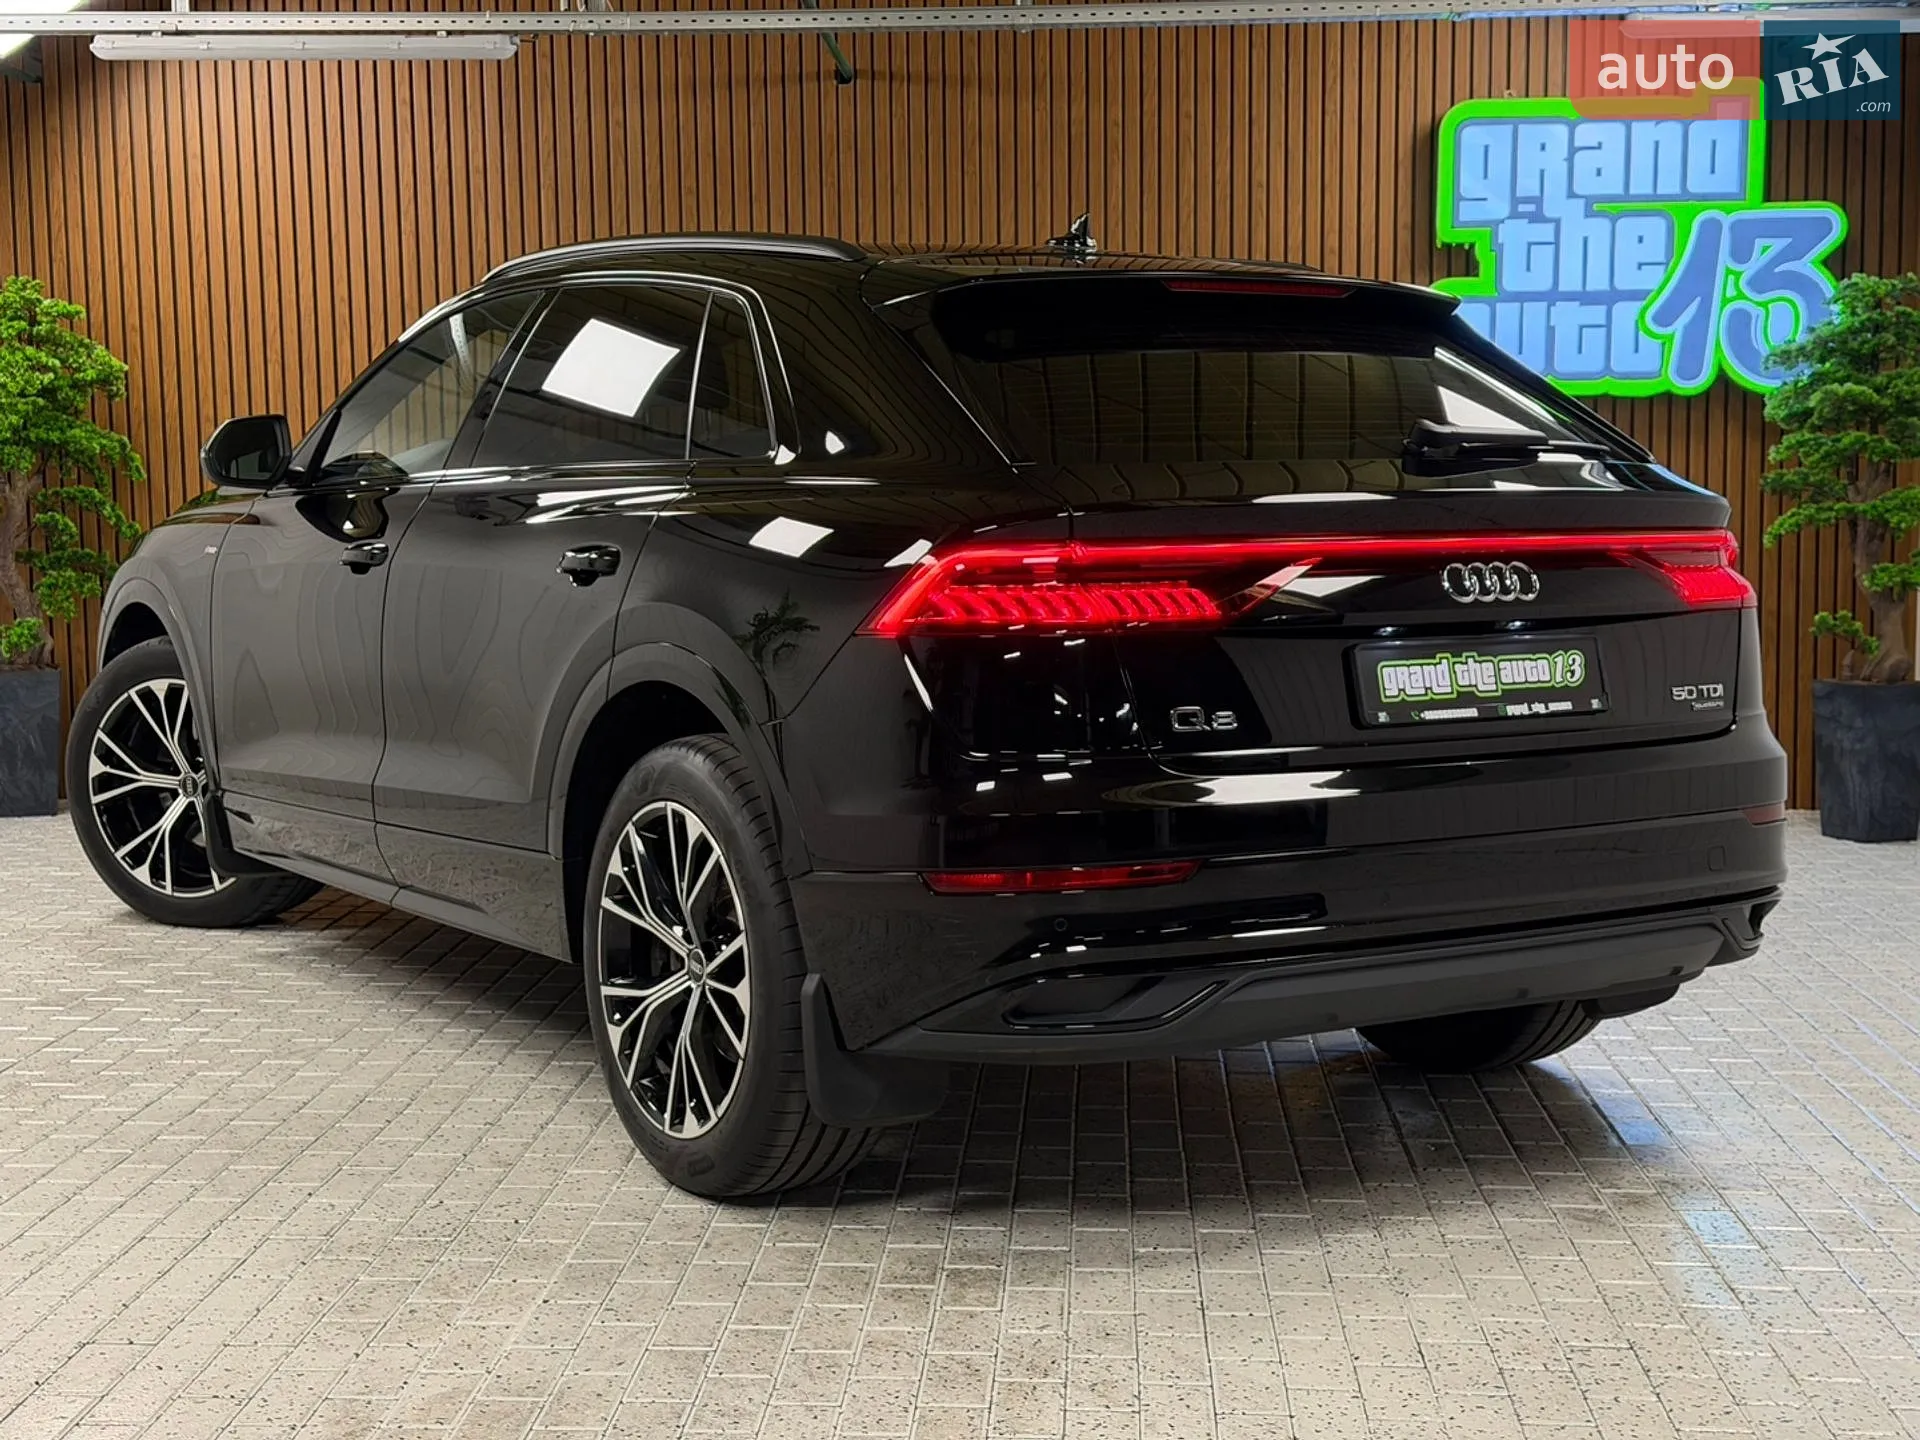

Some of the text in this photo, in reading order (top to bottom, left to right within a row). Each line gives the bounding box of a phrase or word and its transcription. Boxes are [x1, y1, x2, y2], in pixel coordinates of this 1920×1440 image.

[1497, 198, 1670, 292] the
[1454, 657, 1497, 691] the
[1671, 683, 1724, 701] 50 TDI
[1169, 705, 1239, 732] Q8
